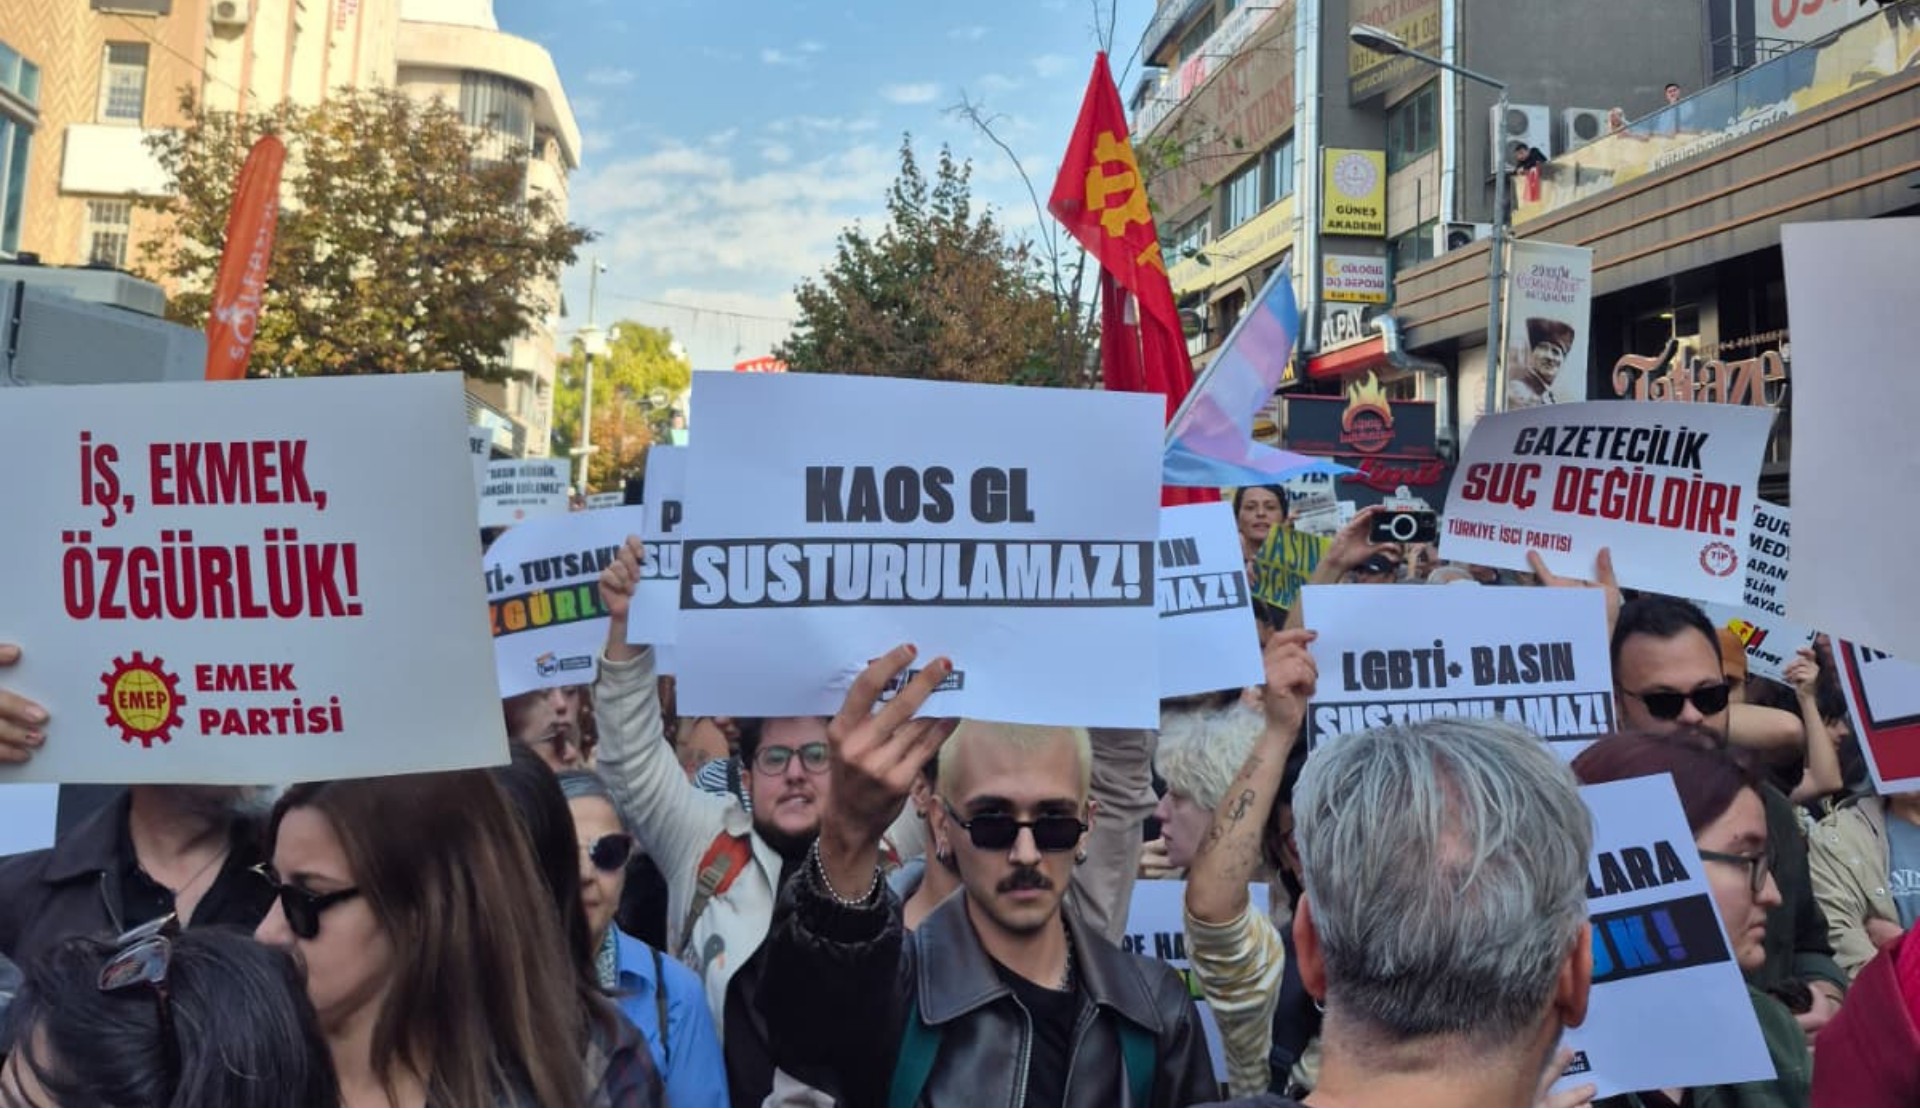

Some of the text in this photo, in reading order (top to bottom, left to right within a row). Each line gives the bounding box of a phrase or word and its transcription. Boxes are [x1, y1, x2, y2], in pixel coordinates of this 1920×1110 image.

[1336, 203, 1377, 218] GÜNEŞ
[1321, 305, 1365, 348] ALPAY
[1513, 425, 1709, 471] GAZETECİLİK
[80, 431, 327, 527] İŞ, EKMEK,
[805, 465, 1036, 524] KAOS GL
[1461, 462, 1742, 537] SUÇ DEĞİLDİR!
[1448, 517, 1496, 541] TÜRKİYE
[1525, 529, 1573, 553] PARTİSİ
[62, 528, 363, 620] ÖZGÜRLÜK!
[691, 542, 1143, 606] SUSTURULAMAZ!
[195, 663, 297, 692] EMEK
[1342, 639, 1576, 692] LGBTİ+ BASIN
[118, 690, 168, 710] EMEP
[199, 696, 344, 736] PARTİSİ
